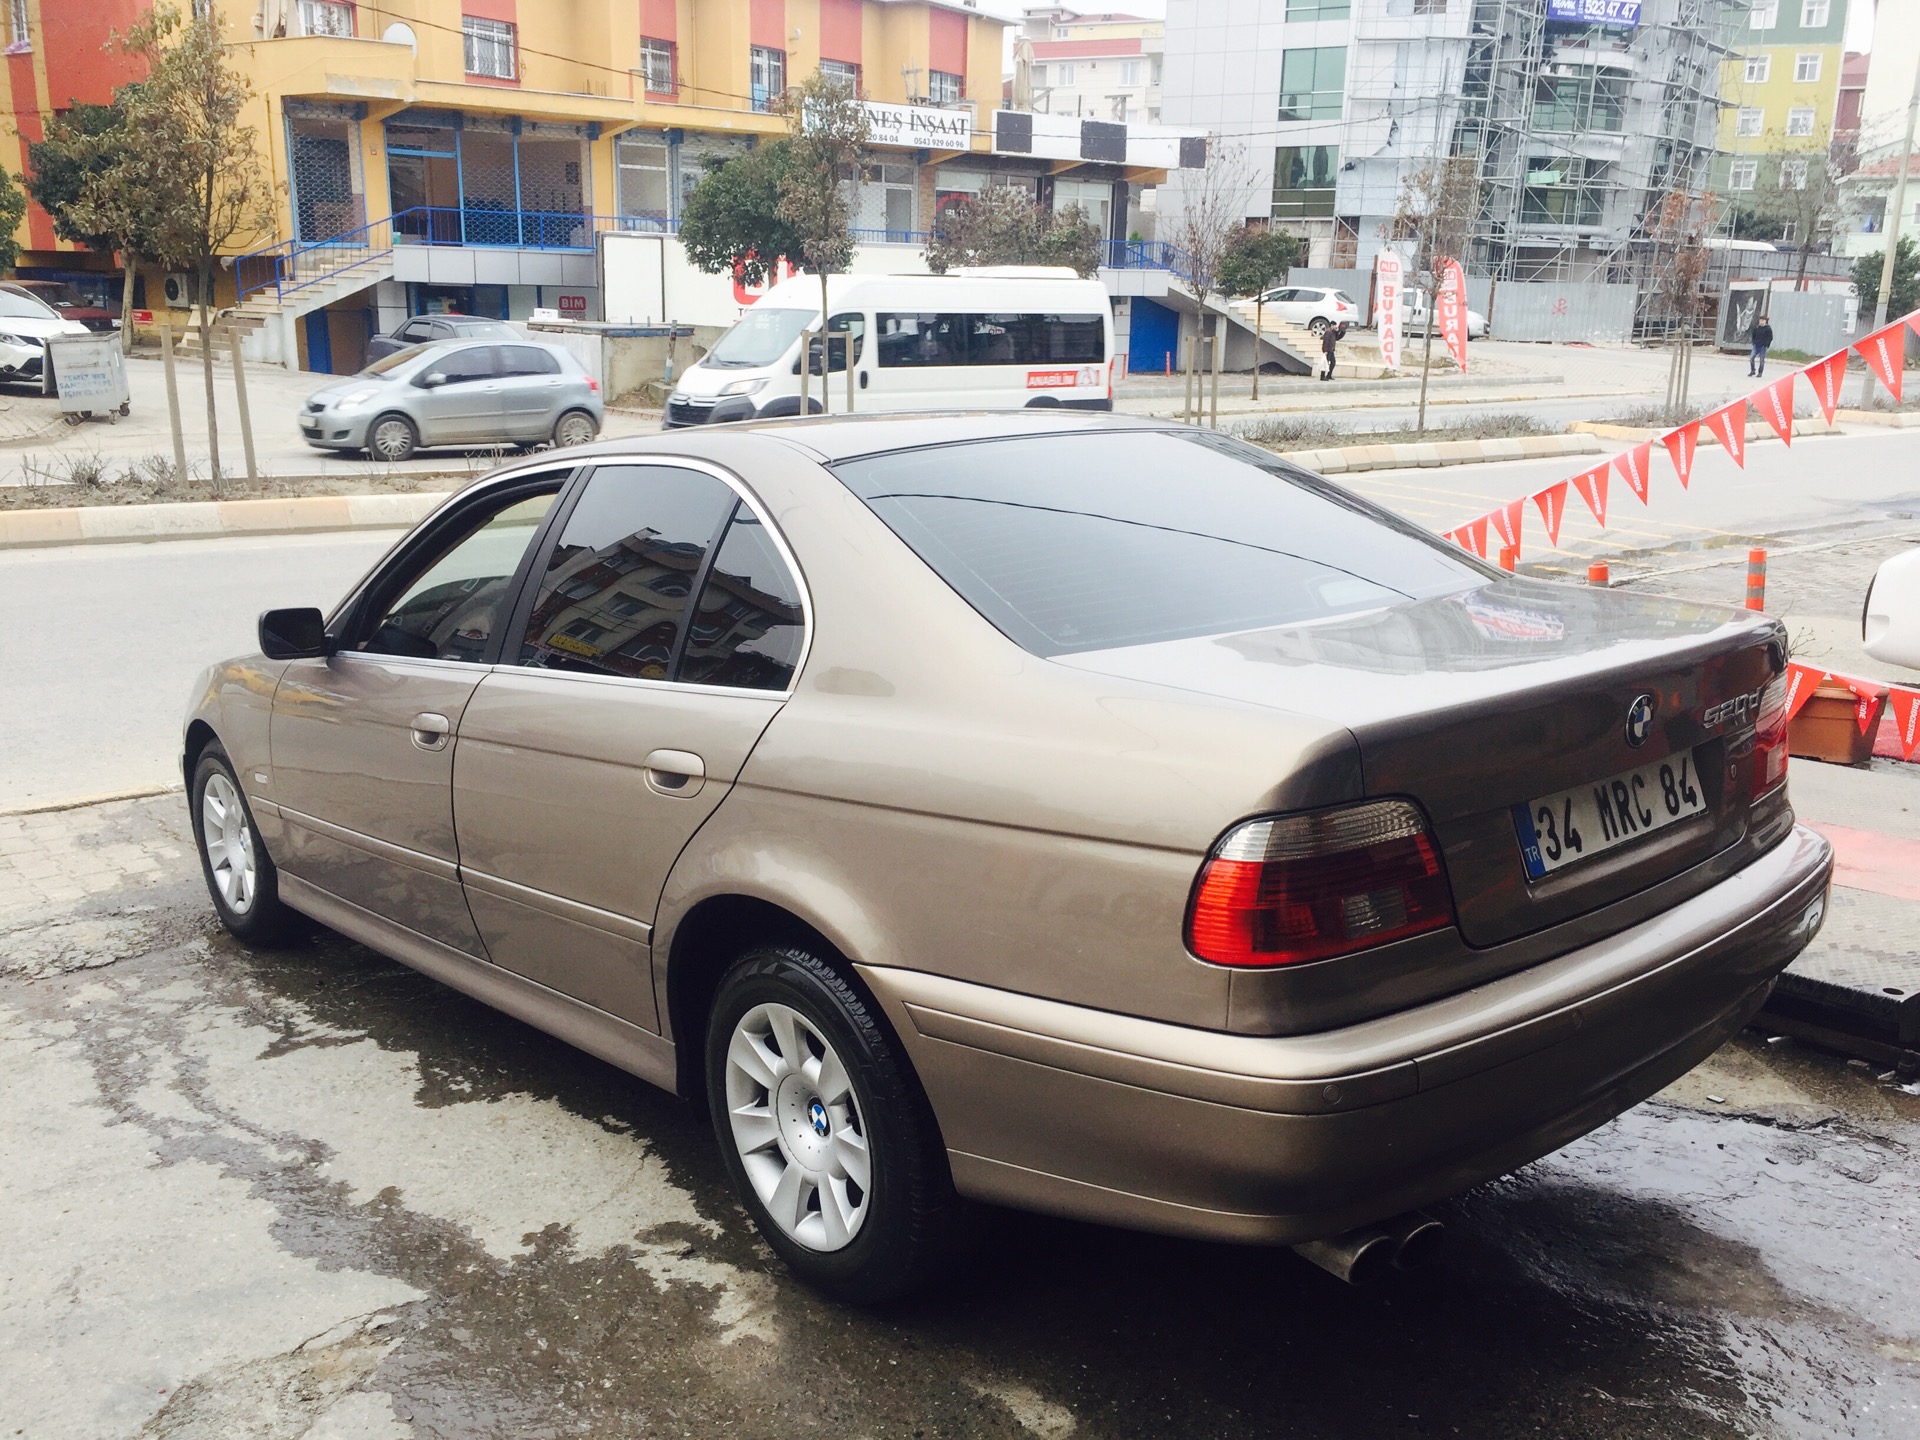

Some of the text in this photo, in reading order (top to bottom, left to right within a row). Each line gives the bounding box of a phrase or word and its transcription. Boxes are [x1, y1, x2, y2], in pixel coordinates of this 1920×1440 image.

[1585, 0, 1605, 15] 523
[1606, 2, 1620, 17] 47
[1621, 3, 1637, 18] 47
[910, 109, 968, 136] İNŞAAT
[914, 137, 964, 148] 0543 929 60 96
[1876, 337, 1896, 385] BRIDGESTONE
[1768, 384, 1788, 431] BRIDGESTONE
[1721, 411, 1740, 457] BRIDGESTONE
[1703, 687, 1760, 728] 520d
[1784, 670, 1804, 714] BRIDGESTO
[1536, 757, 1698, 861] 34 MRC 84
[1525, 846, 1541, 863] TR
